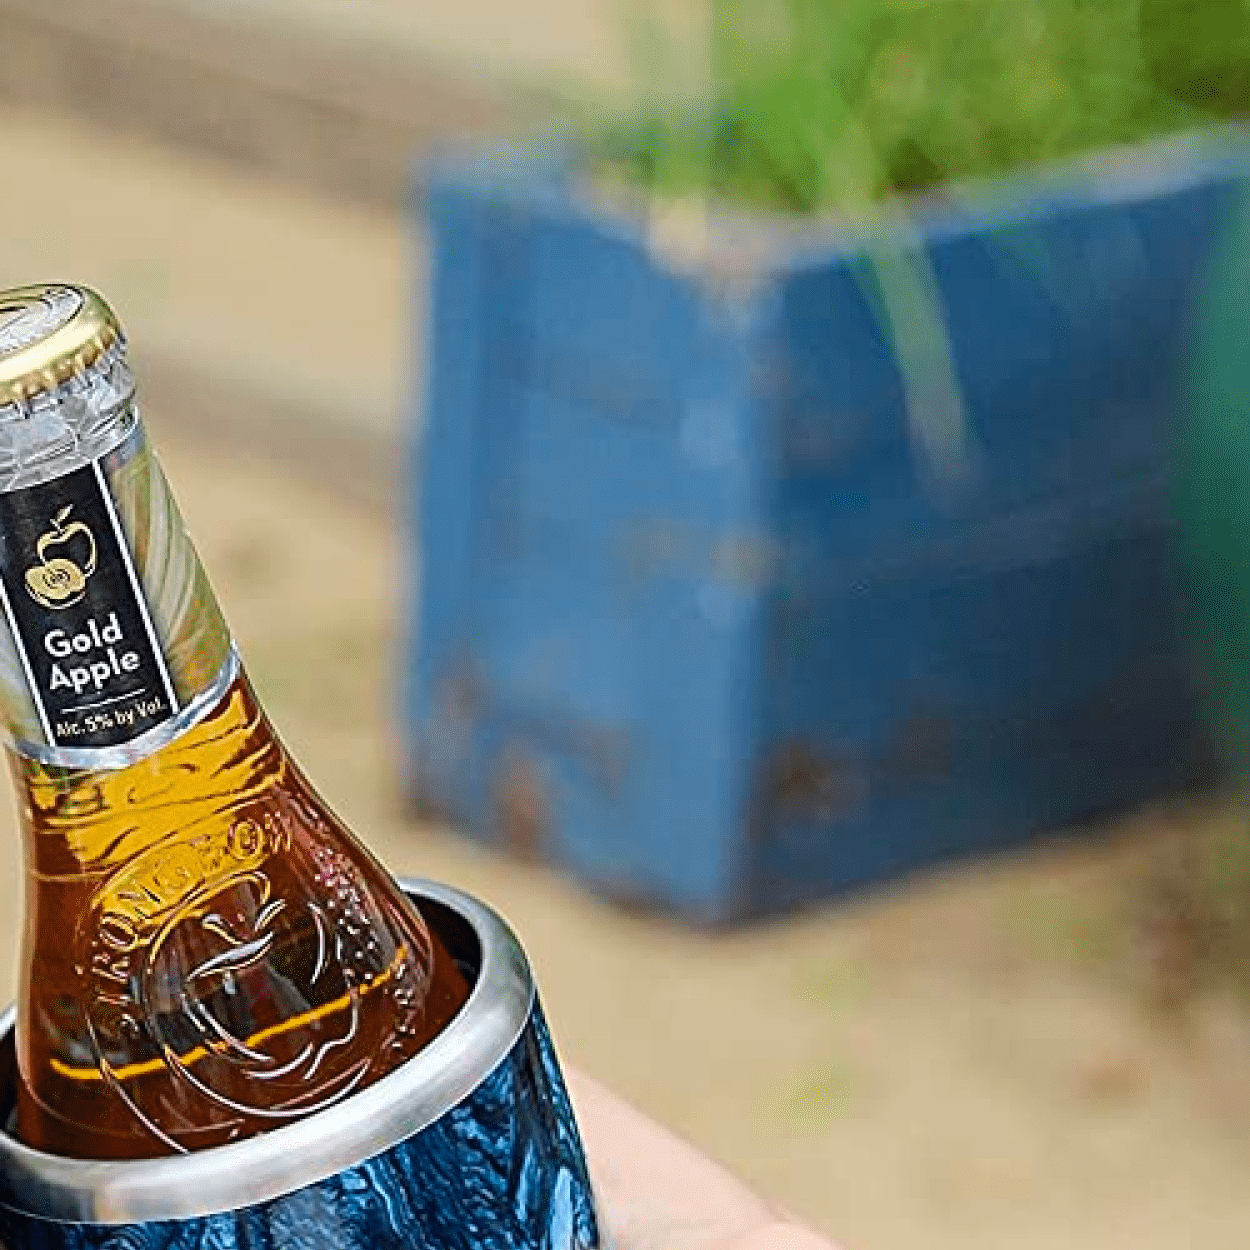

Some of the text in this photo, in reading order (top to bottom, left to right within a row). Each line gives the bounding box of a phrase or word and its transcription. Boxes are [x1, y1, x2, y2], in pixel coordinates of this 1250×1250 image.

[44, 611, 124, 657] Gold
[49, 646, 141, 694] Apple
[114, 710, 134, 725] by
